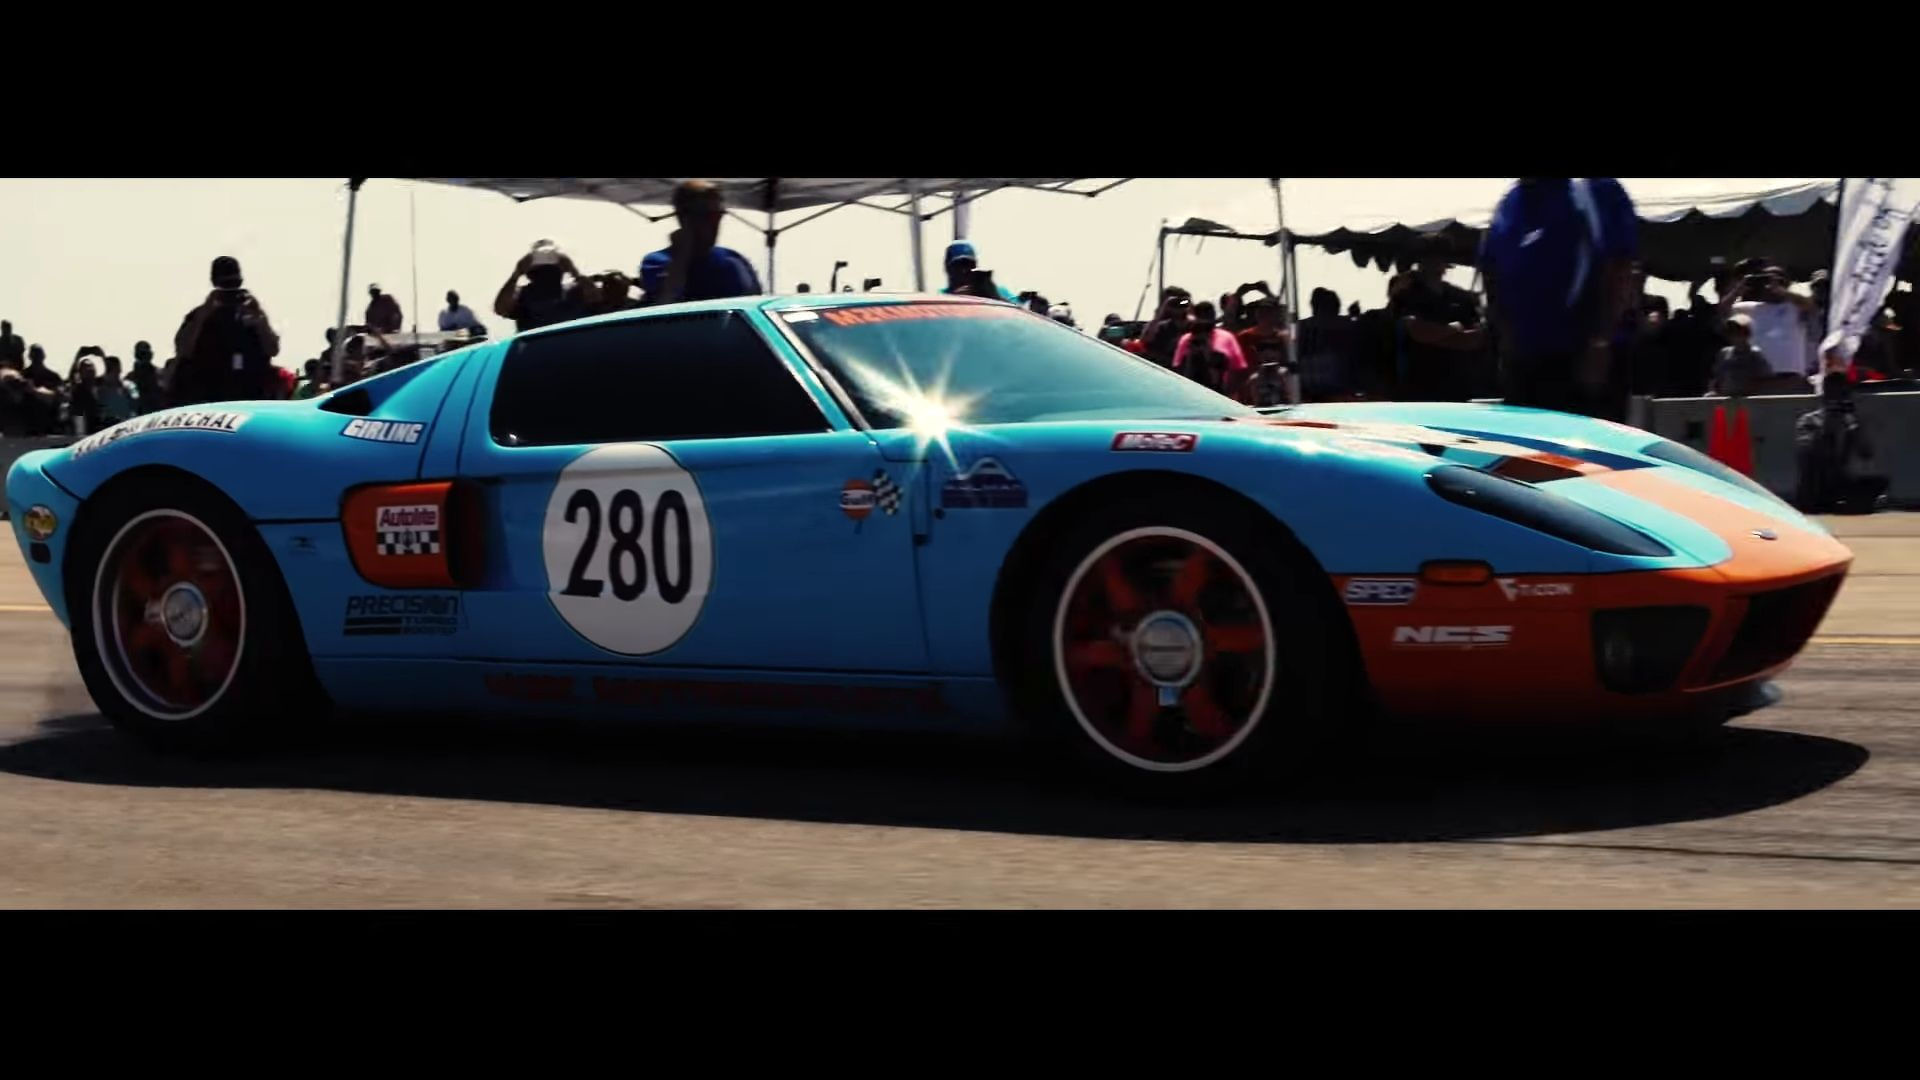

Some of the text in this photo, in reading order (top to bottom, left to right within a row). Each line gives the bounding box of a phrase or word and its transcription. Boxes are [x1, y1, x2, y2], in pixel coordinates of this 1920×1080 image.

[144, 412, 237, 430] MARCHAL
[343, 419, 423, 443] GIRLING
[379, 508, 436, 527] Autolite
[562, 489, 692, 605] 280
[1346, 582, 1415, 600] SPEC
[346, 595, 459, 615] PRECISION
[1393, 625, 1514, 643] NCS
